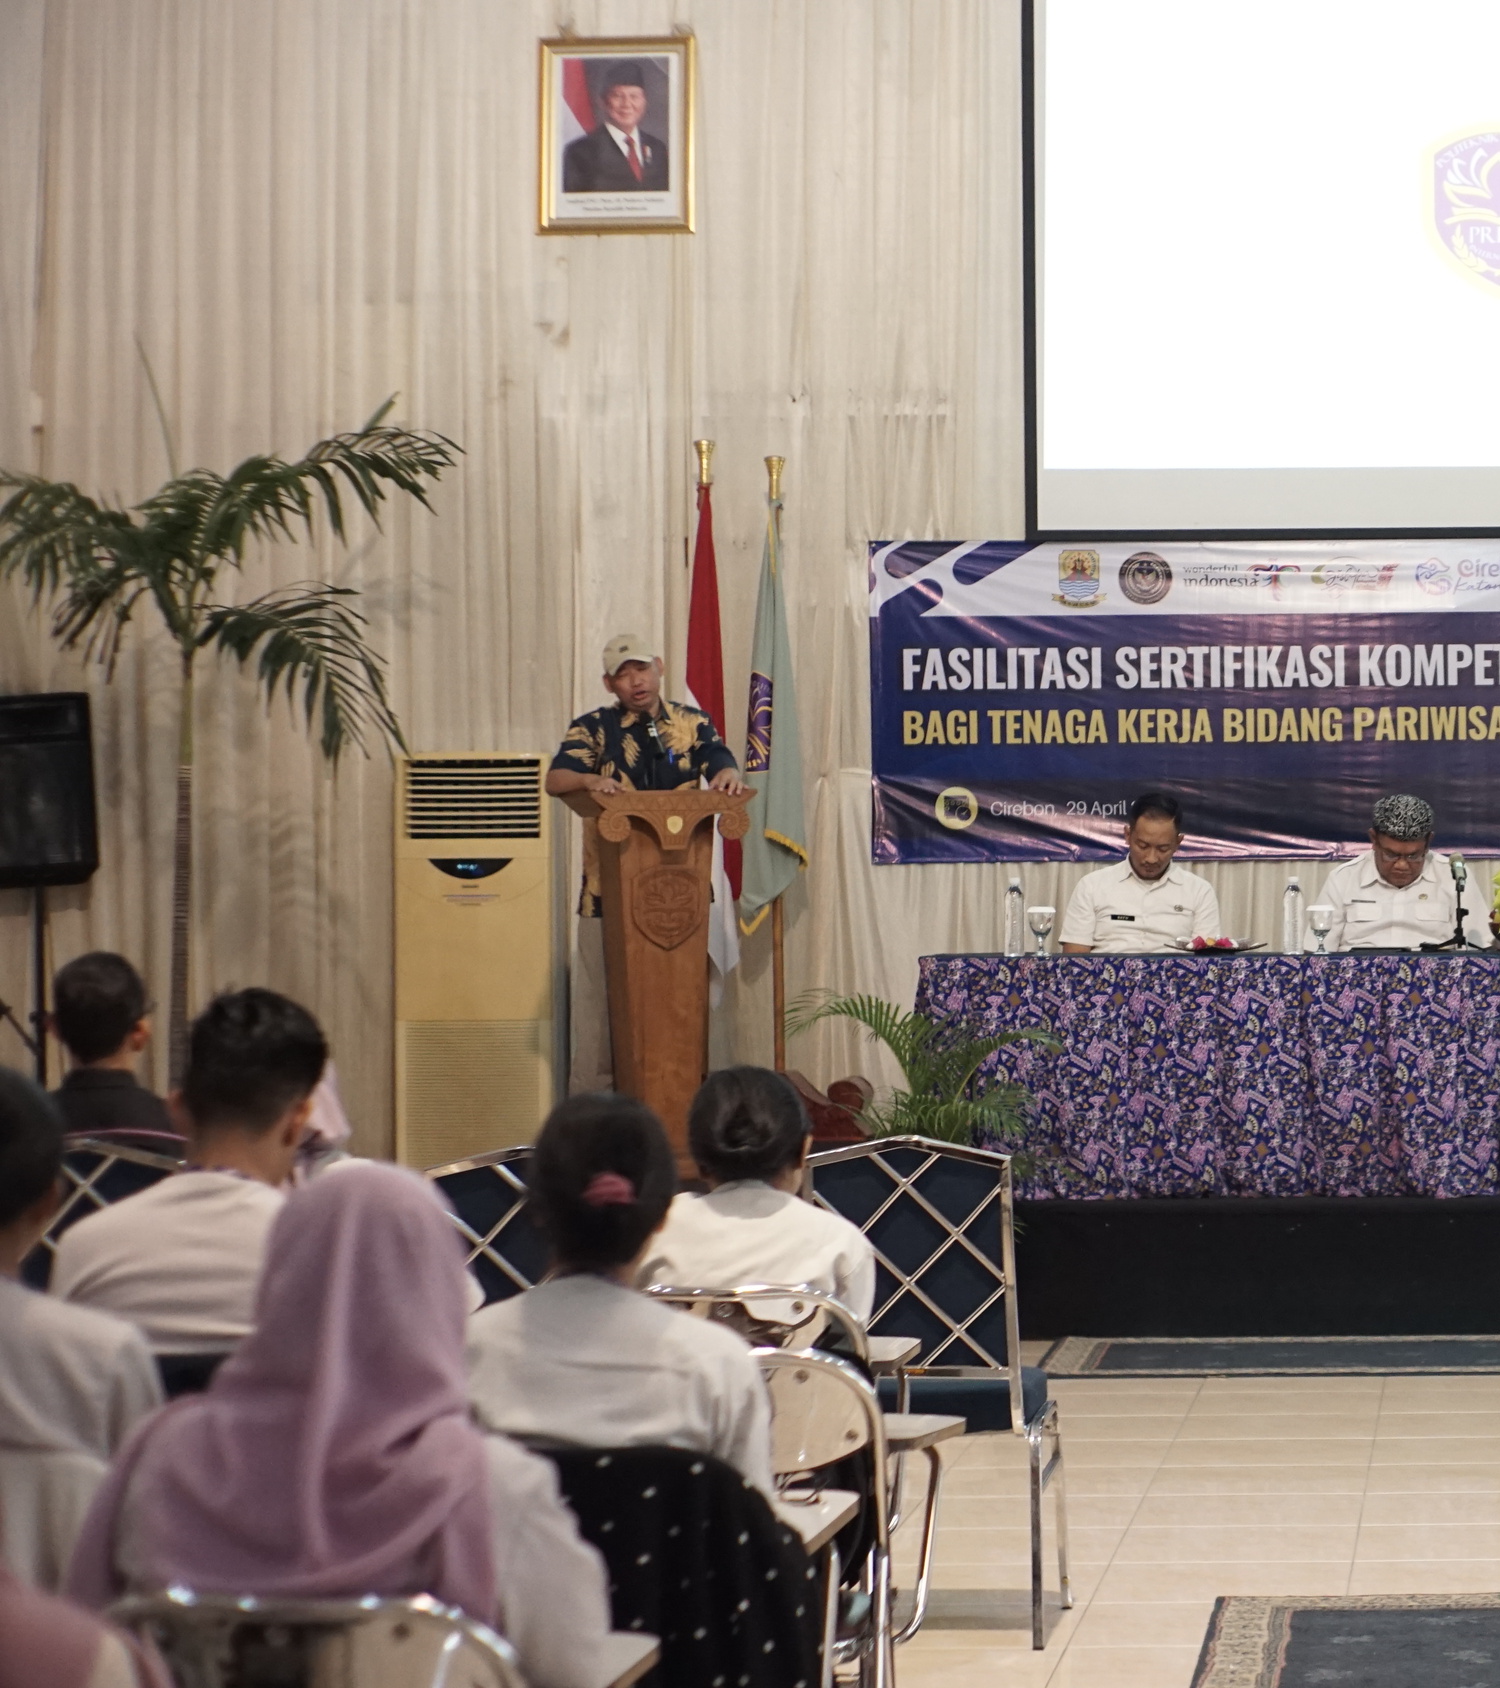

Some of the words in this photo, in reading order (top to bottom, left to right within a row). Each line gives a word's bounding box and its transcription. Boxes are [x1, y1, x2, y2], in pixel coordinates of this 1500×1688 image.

[1436, 134, 1500, 168] POLITEKNIK
[1183, 565, 1239, 574] wonderful
[1183, 574, 1258, 588] indonesia
[902, 646, 1102, 691] FASILITASI
[1115, 645, 1347, 689] SERTIFIKASI
[903, 709, 978, 745] BAGI
[987, 708, 1108, 744] TENAGA
[1117, 708, 1213, 744] KERJA
[1223, 706, 1343, 743] BIDANG
[990, 800, 1058, 817] Cirebon,
[1066, 800, 1087, 816] 29
[1091, 800, 1127, 818] April
